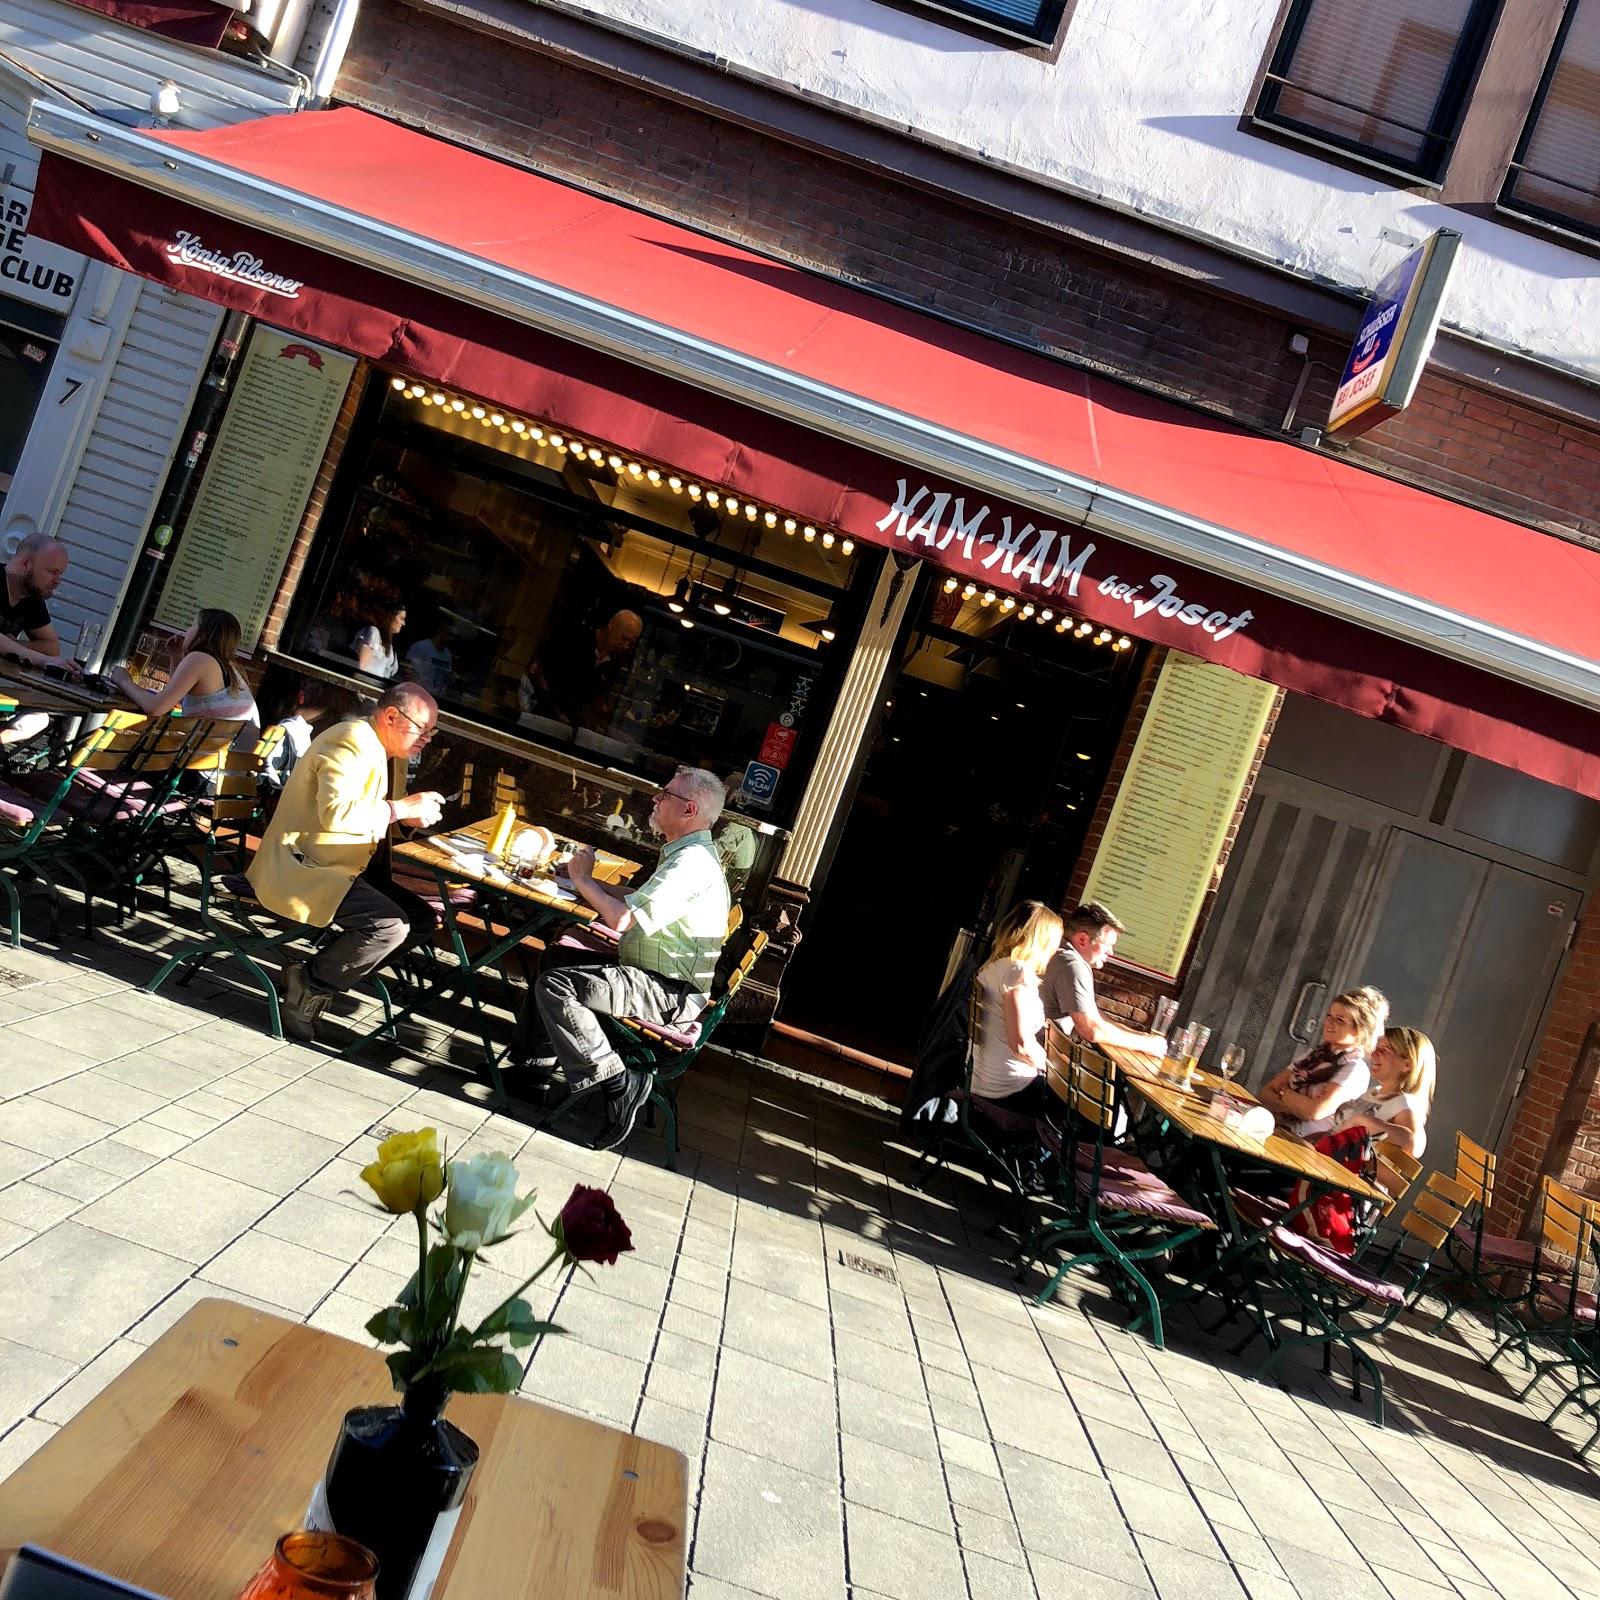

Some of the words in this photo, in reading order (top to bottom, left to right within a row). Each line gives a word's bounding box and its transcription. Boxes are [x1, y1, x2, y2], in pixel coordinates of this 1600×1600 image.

[0, 255, 75, 297] CLUB
[166, 230, 232, 274] König
[226, 251, 304, 293] Pilsener
[58, 377, 84, 406] 7
[1349, 367, 1378, 398] JOSEF
[876, 478, 1096, 597] HAM-HAM
[1097, 575, 1134, 606] bei
[1133, 573, 1254, 642] Josef
[748, 778, 771, 792] WLAN
